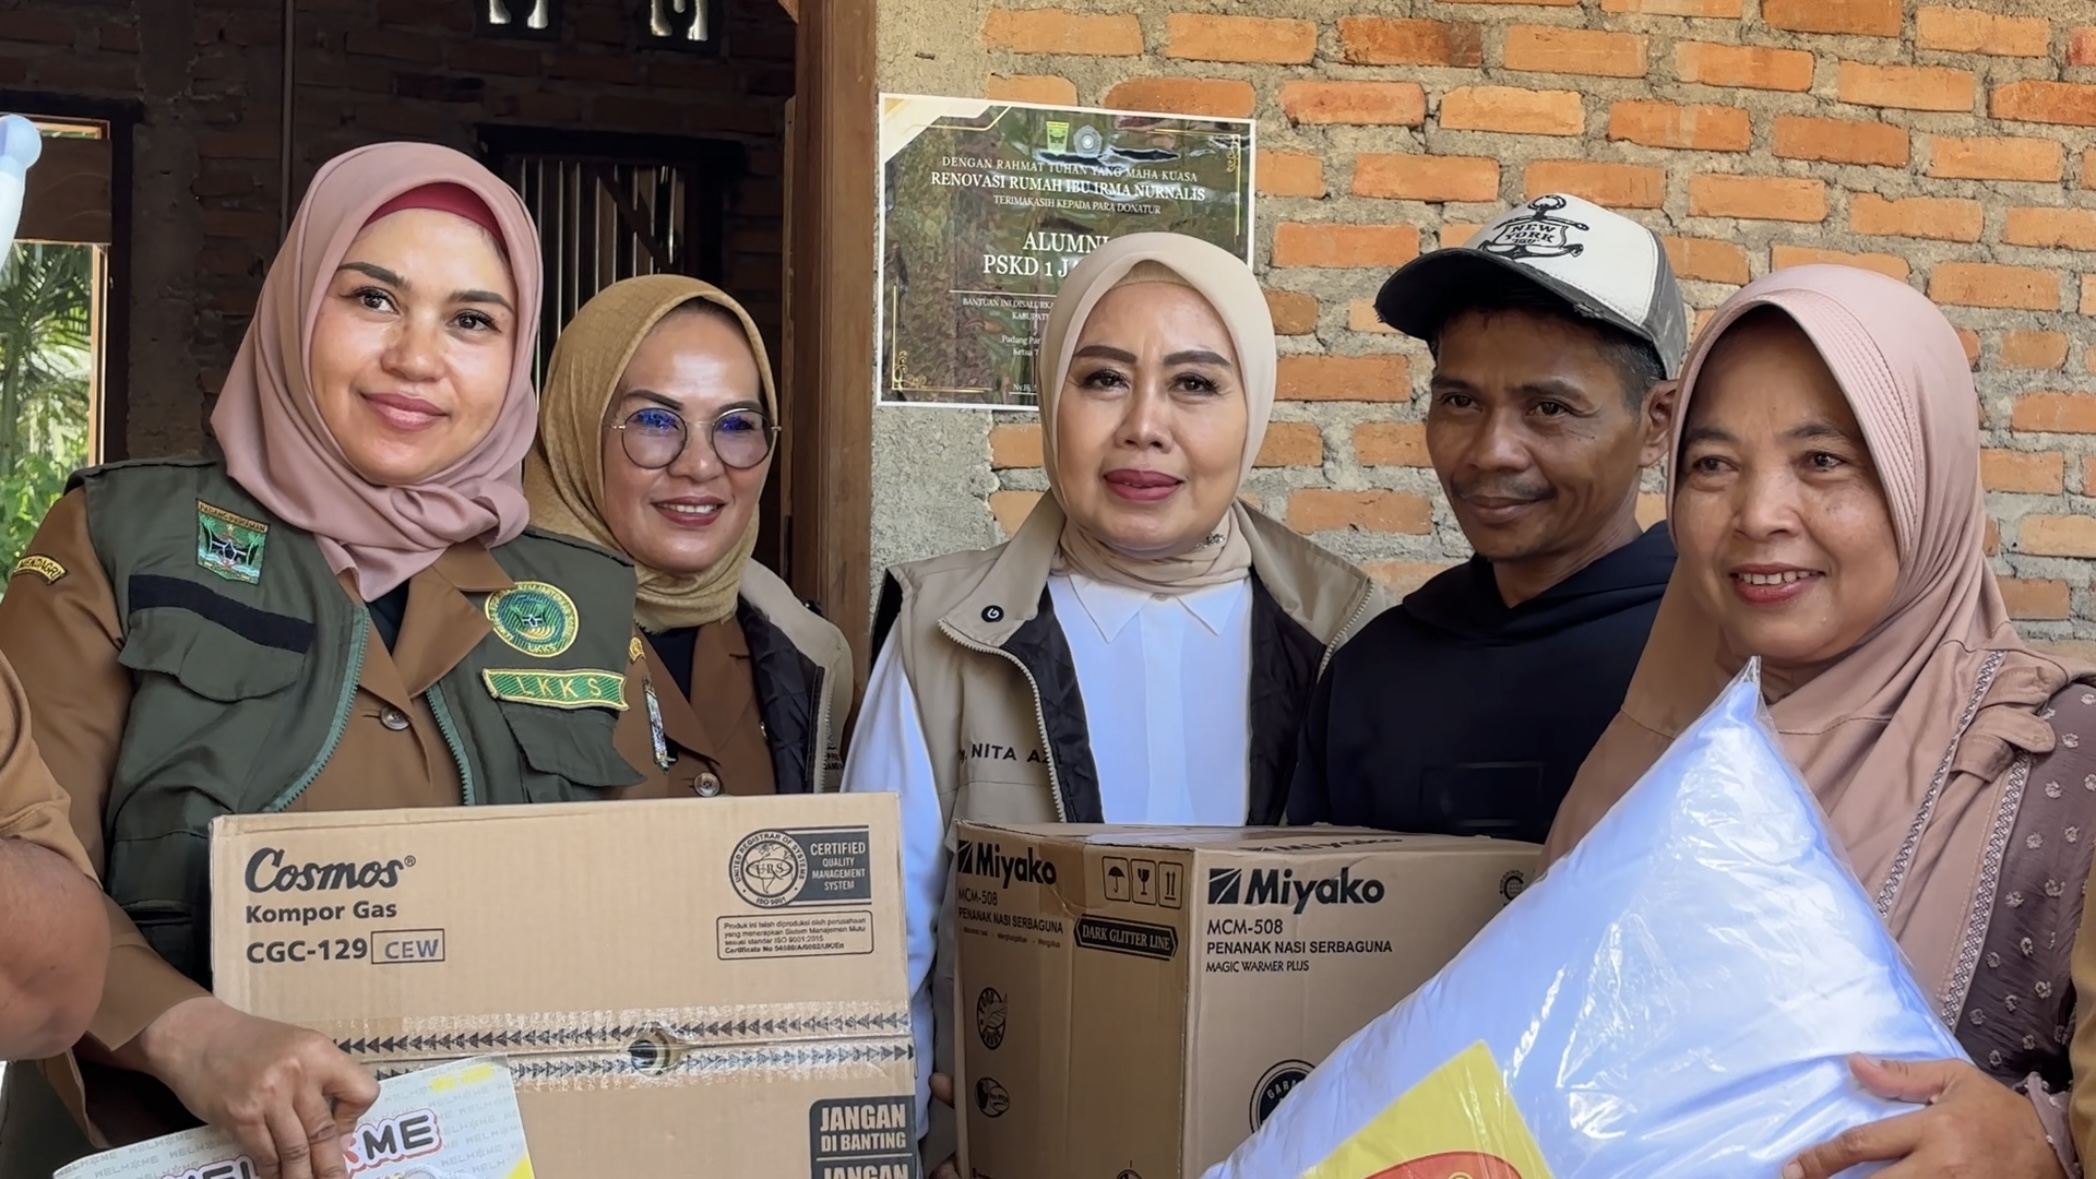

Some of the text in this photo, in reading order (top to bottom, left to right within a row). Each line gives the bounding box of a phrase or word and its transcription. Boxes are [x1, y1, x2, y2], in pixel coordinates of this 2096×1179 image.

[941, 156, 1198, 182] DENGAN RAHMAT TUHAN YANG MAHA KUASA
[931, 171, 1206, 201] RENOVASI RUMAH IBU IRMA NURNALIS
[993, 195, 1161, 214] TERIMAKASIH KEPADA PARA DONATUR
[1505, 231, 1555, 243] YORK
[1510, 223, 1556, 233] NEW
[983, 254, 1039, 276] PSKD
[1044, 261, 1053, 276] 1
[962, 297, 1000, 307] BANTUAN
[516, 676, 601, 699] LKKS
[971, 743, 1017, 762] NITA
[734, 833, 806, 883] UNITED REGISTRAR OF SYSTEMS
[810, 842, 866, 856] CERTIFIED
[822, 857, 855, 867] QUALITY
[976, 842, 1057, 889] Miyako
[811, 868, 866, 879] MANAGEMENT
[824, 881, 855, 891] SYSTEM
[1245, 867, 1385, 914] Miyako
[958, 887, 998, 906] MCM-508
[246, 901, 397, 926] Kompor Gas
[958, 907, 1064, 935] PENANAK NASI SERBAGUNA
[724, 921, 748, 930] Produk
[1207, 919, 1283, 935] MCM-508
[1082, 924, 1108, 942] DARK
[1109, 927, 1148, 947] GLITTER
[1149, 933, 1171, 951] LINE
[1207, 940, 1392, 954] PENANAK NASI SERBAGUNA
[247, 937, 439, 963] CGC-129 CEW
[1206, 960, 1310, 973] MAGIC WARMER PLUS
[820, 1103, 906, 1132] JANGAN
[821, 1131, 906, 1152] DI BANTING
